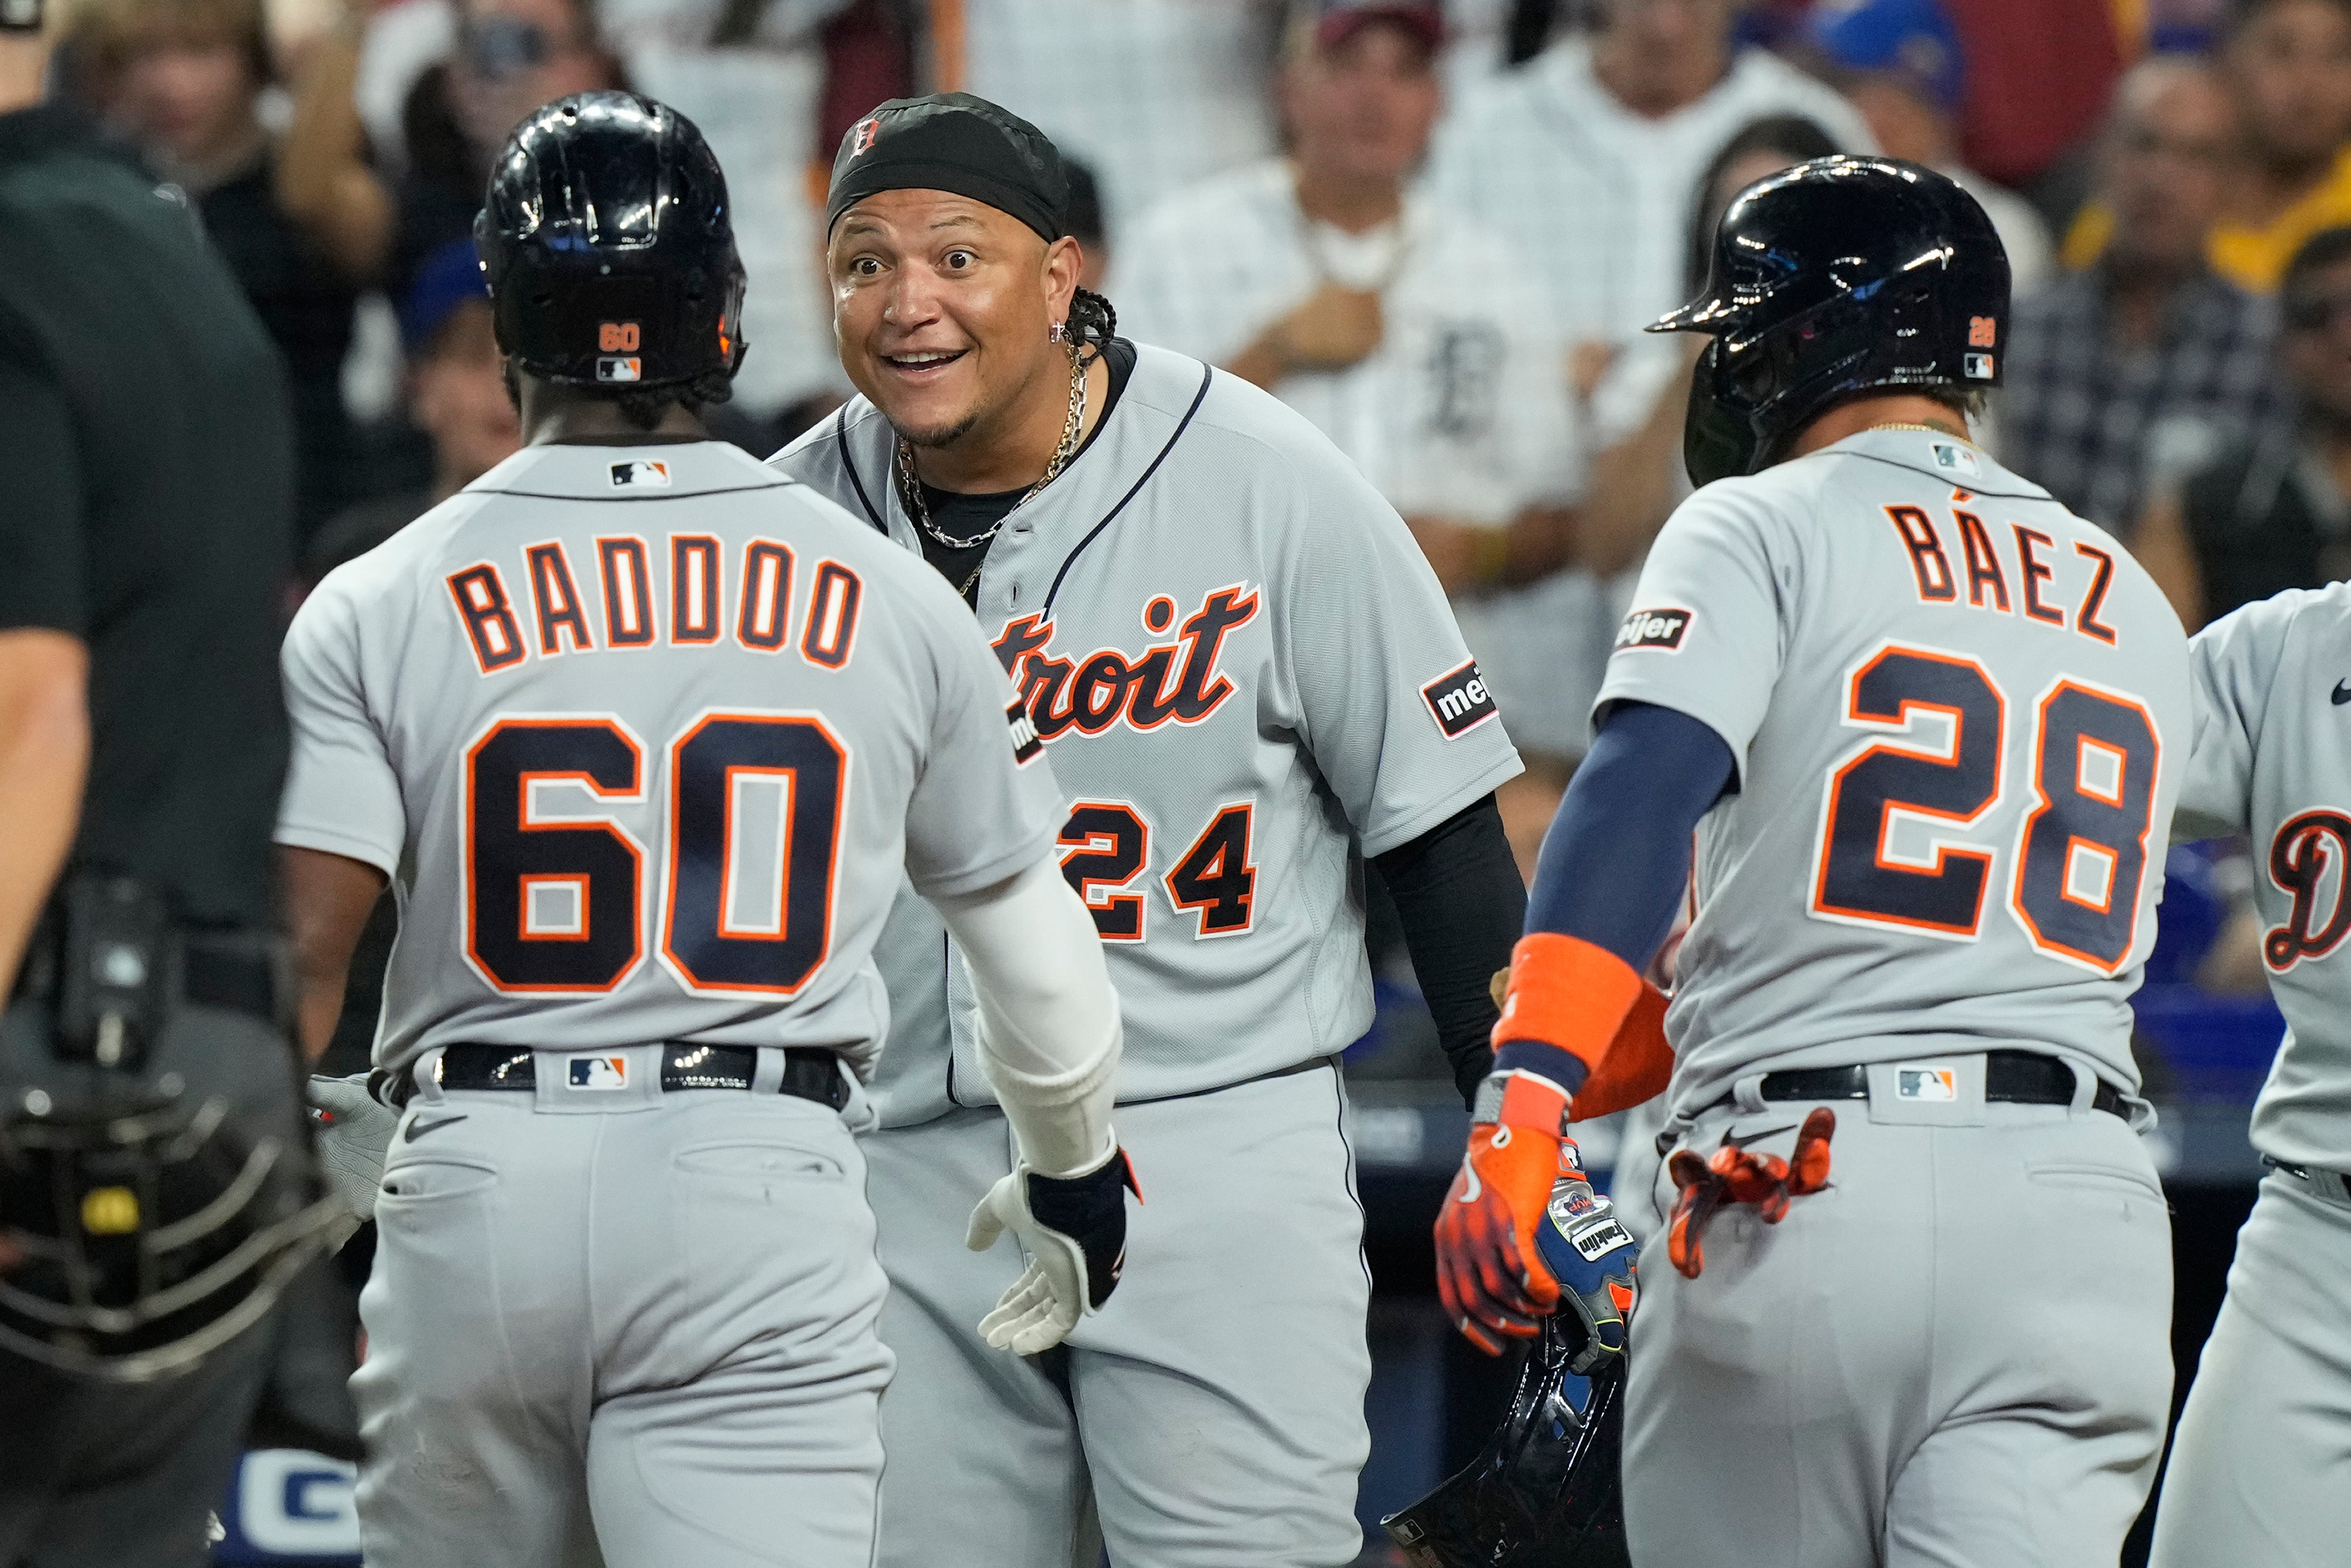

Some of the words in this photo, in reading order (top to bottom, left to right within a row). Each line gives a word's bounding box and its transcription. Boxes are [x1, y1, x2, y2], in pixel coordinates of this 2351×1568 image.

[598, 322, 640, 352] 60
[1968, 315, 1996, 348] 28
[445, 533, 866, 678] BADDOO
[1614, 612, 1683, 646] ijer
[1880, 486, 2120, 648] BÁEZ
[990, 580, 1261, 744] troit
[1437, 666, 1491, 722] mei
[459, 707, 853, 1002] 60
[1054, 797, 1260, 944] 24
[1806, 638, 2163, 979] 28
